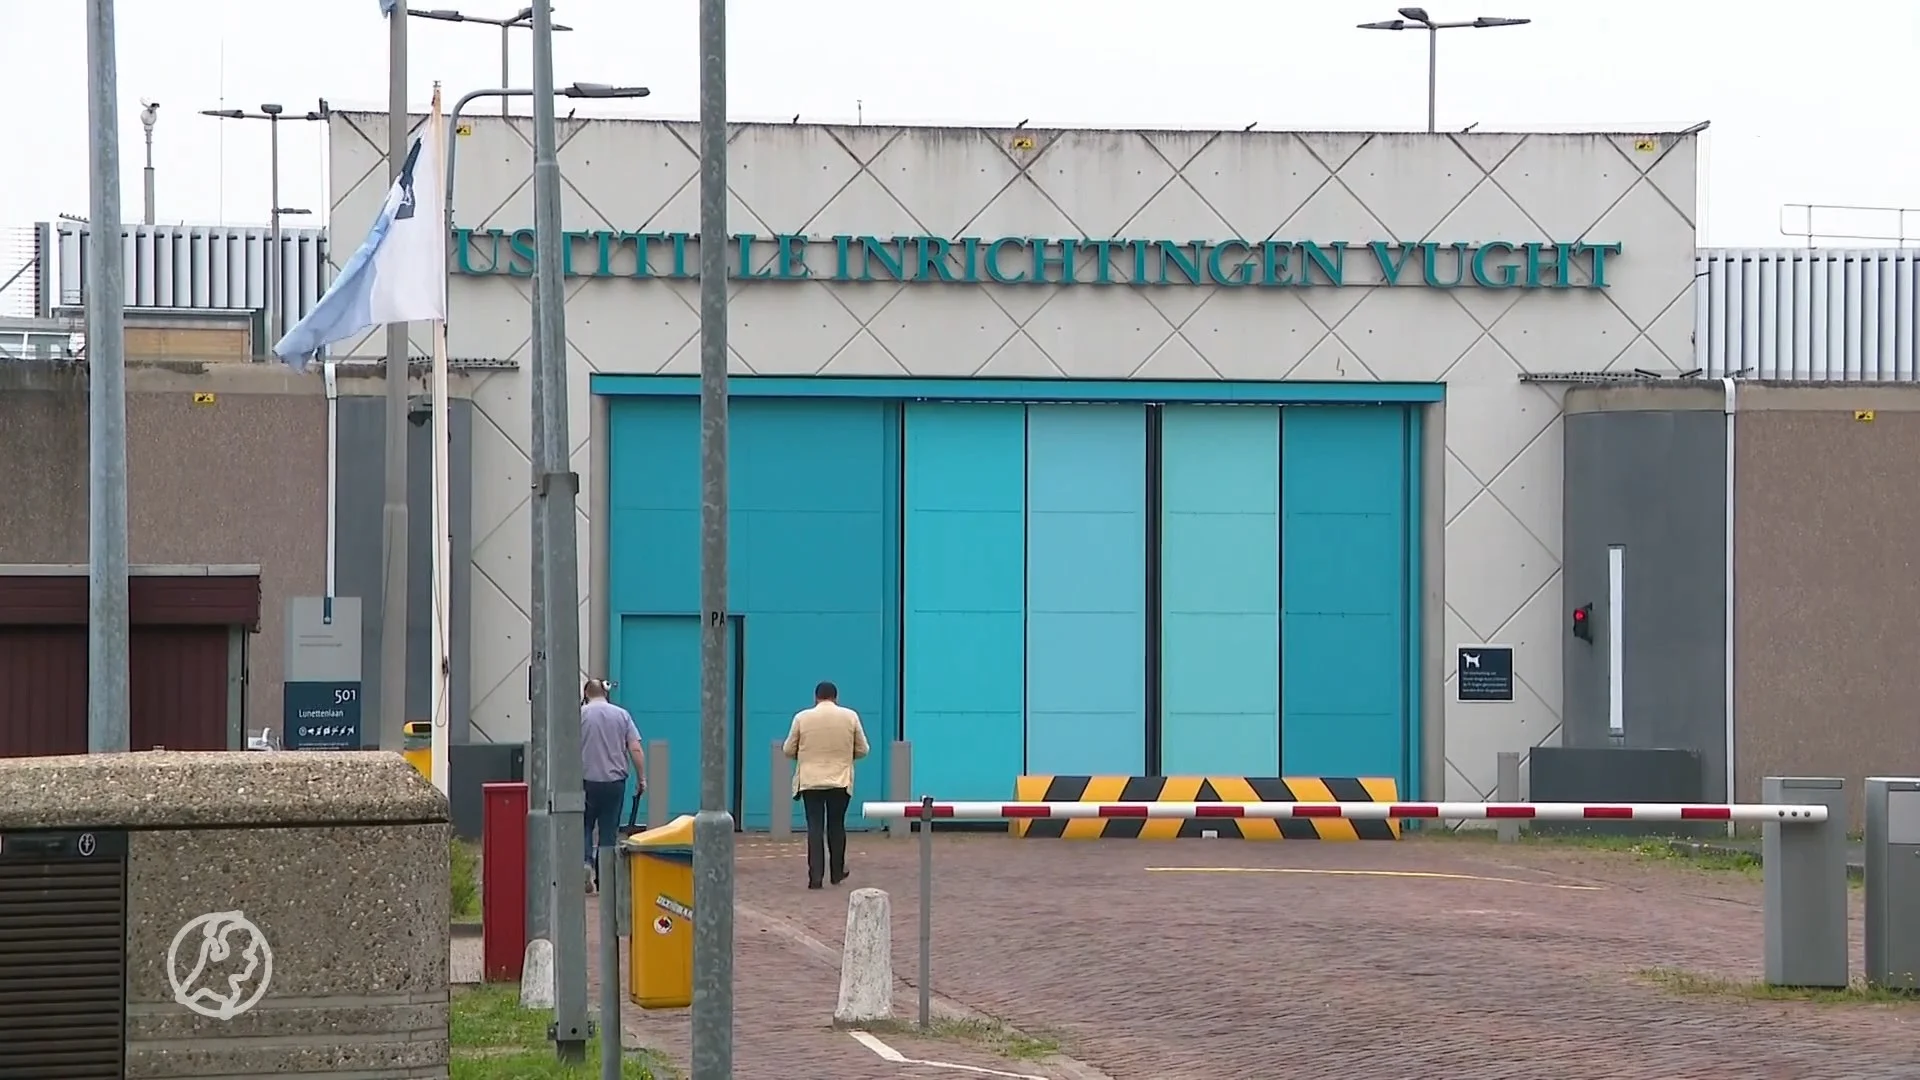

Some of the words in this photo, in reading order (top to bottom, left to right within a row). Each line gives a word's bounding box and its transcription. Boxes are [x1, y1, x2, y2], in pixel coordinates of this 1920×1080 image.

[451, 228, 811, 280] USTITILE
[831, 235, 1348, 287] INRICHTINGEN
[1367, 240, 1622, 289] VUGHT
[711, 611, 725, 627] PA
[335, 689, 356, 704] 501
[298, 709, 344, 718] Lunettenlaan
